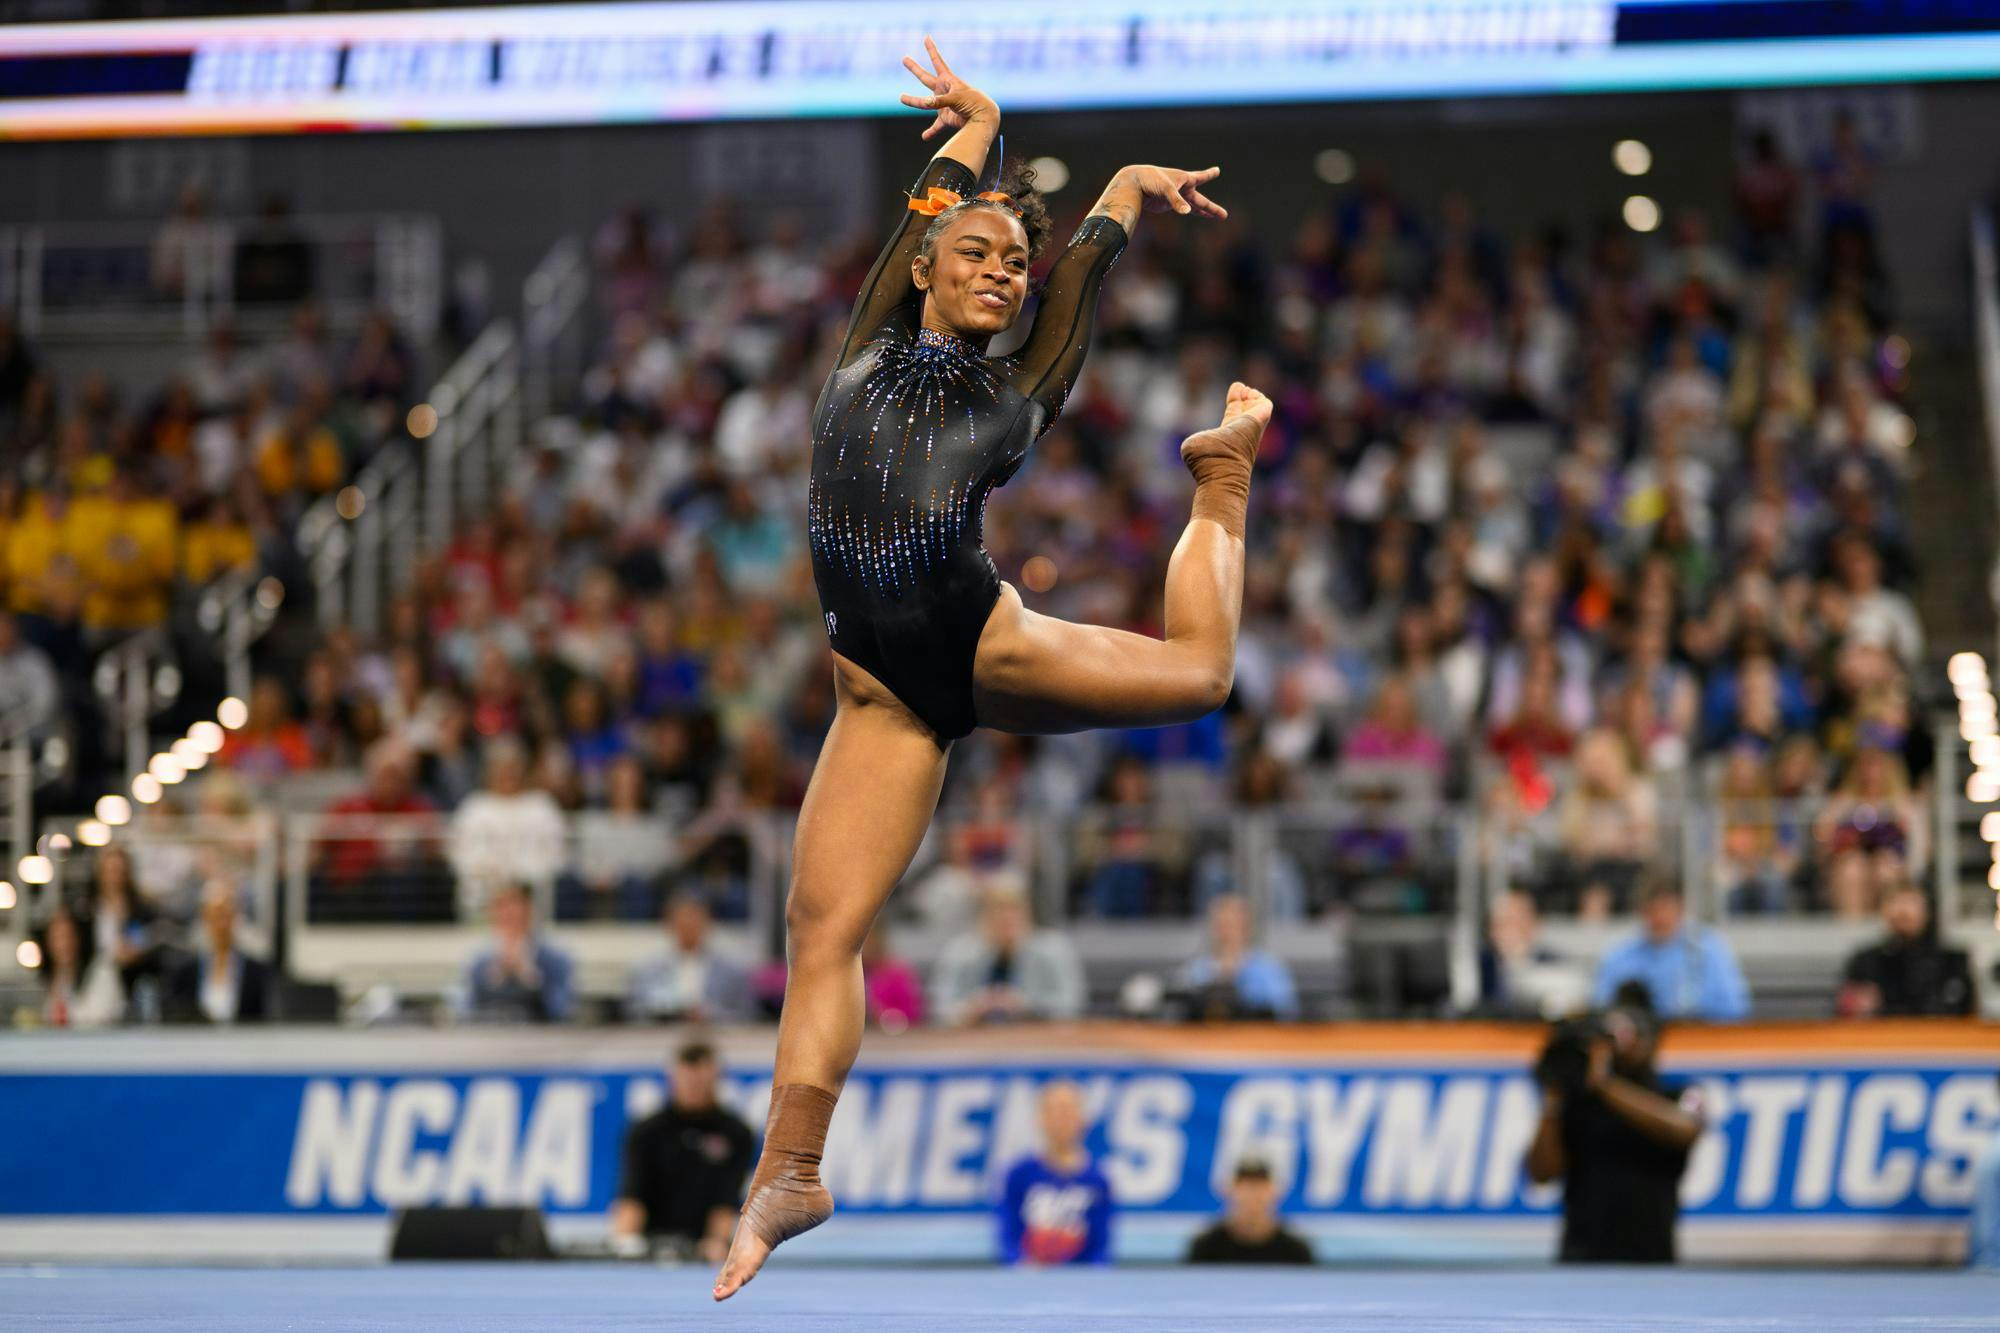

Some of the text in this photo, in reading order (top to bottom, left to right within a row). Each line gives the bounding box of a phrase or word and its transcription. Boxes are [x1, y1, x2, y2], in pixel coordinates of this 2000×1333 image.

[286, 1076, 2000, 1208] NCAA ME'S GYMTICS
